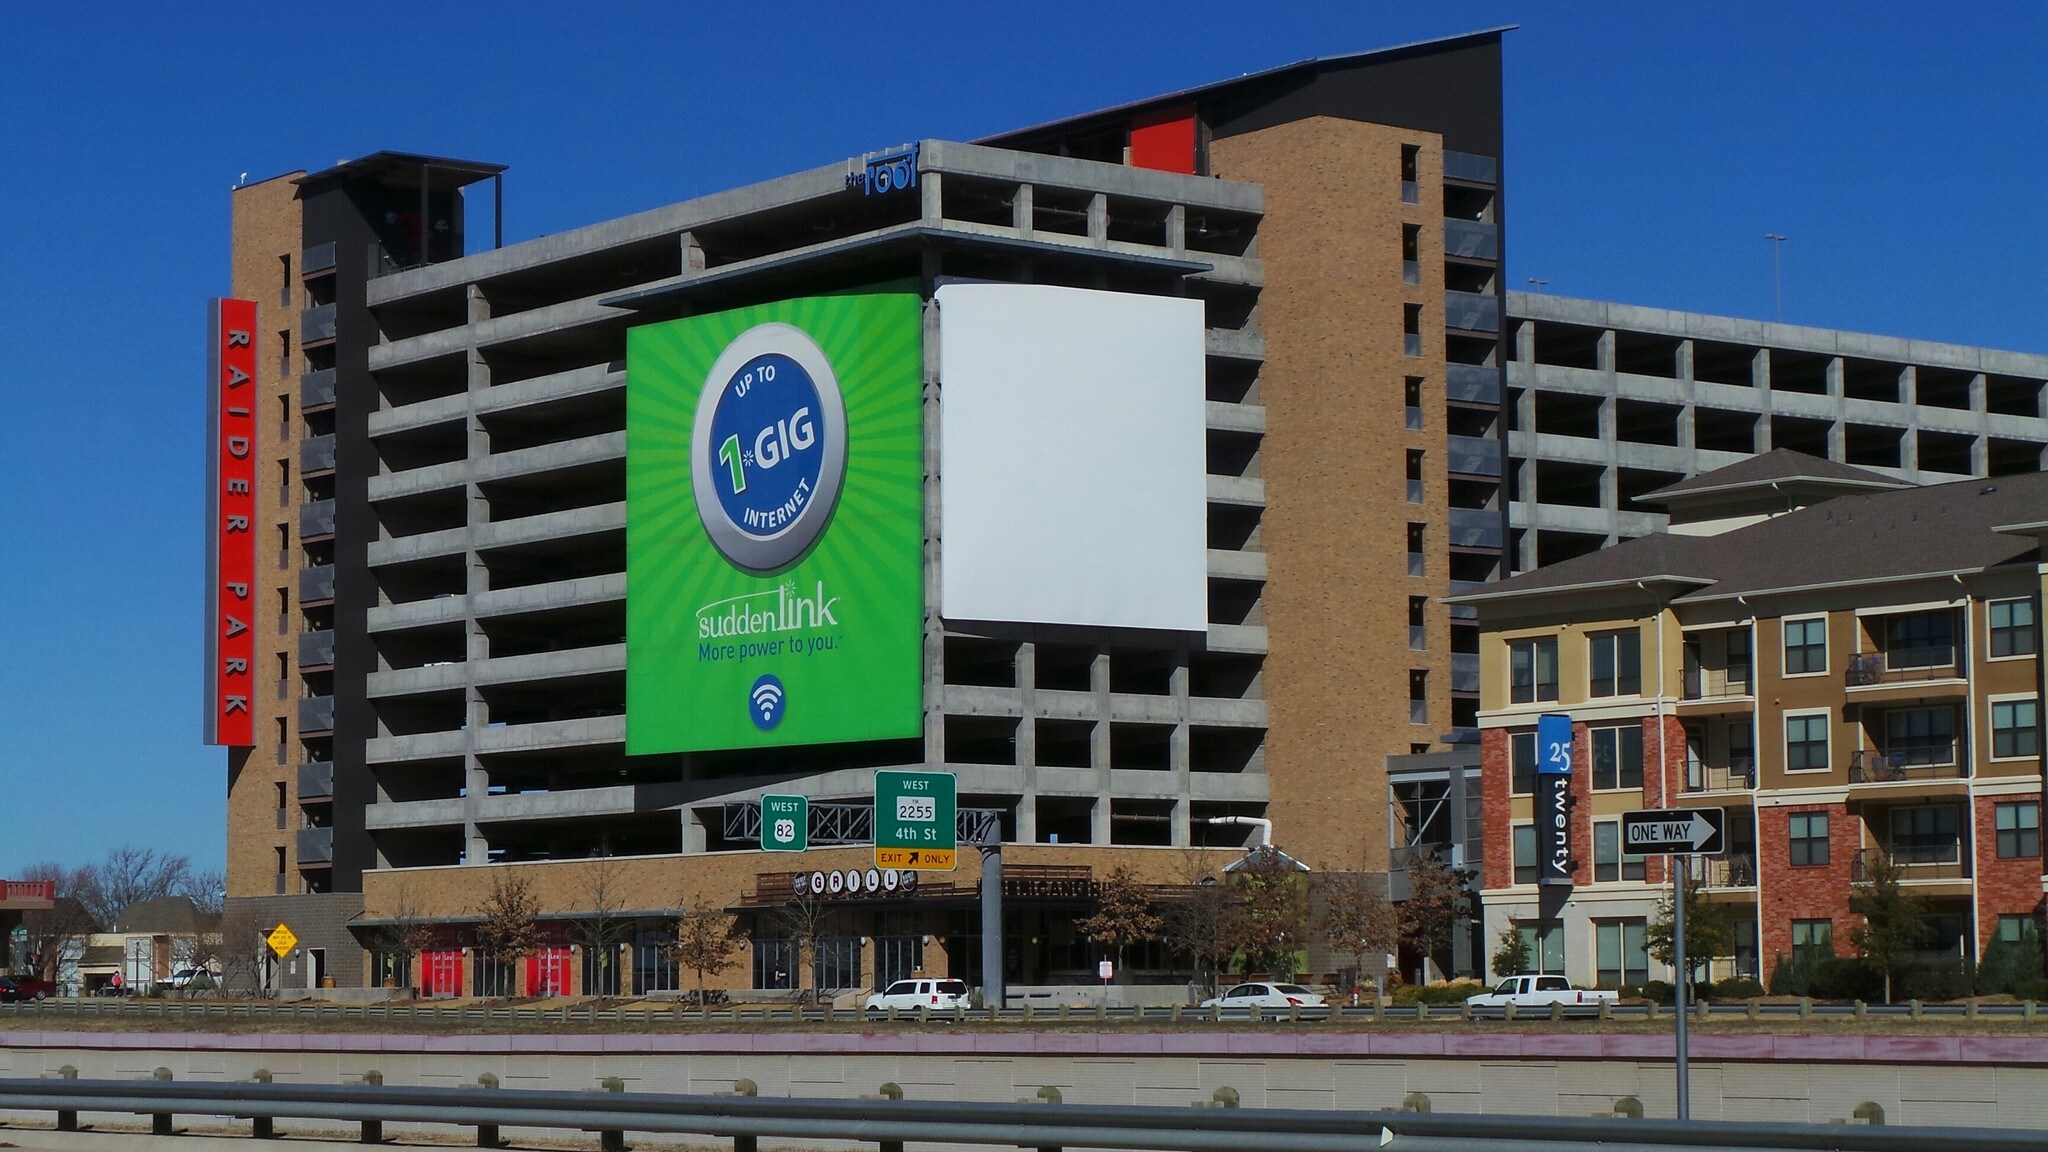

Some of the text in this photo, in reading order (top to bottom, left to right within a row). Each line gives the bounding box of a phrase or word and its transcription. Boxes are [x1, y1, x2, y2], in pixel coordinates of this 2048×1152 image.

[845, 172, 865, 187] the
[735, 365, 776, 398] UP TO
[744, 477, 810, 528] INTERNET
[225, 329, 250, 714] RAIDER PARK
[698, 579, 838, 639] suddenlink
[699, 635, 838, 663] More power to you.
[1549, 741, 1571, 772] 25
[902, 780, 930, 790] WEST
[771, 802, 799, 813] WEST
[899, 806, 933, 819] 2255
[776, 824, 793, 838] 82
[895, 827, 937, 840] 4th St
[1552, 777, 1569, 874] twenty
[1631, 823, 1691, 841] ONE WAY
[881, 853, 950, 864] EXIT ONLY
[813, 872, 895, 890] GRILL
